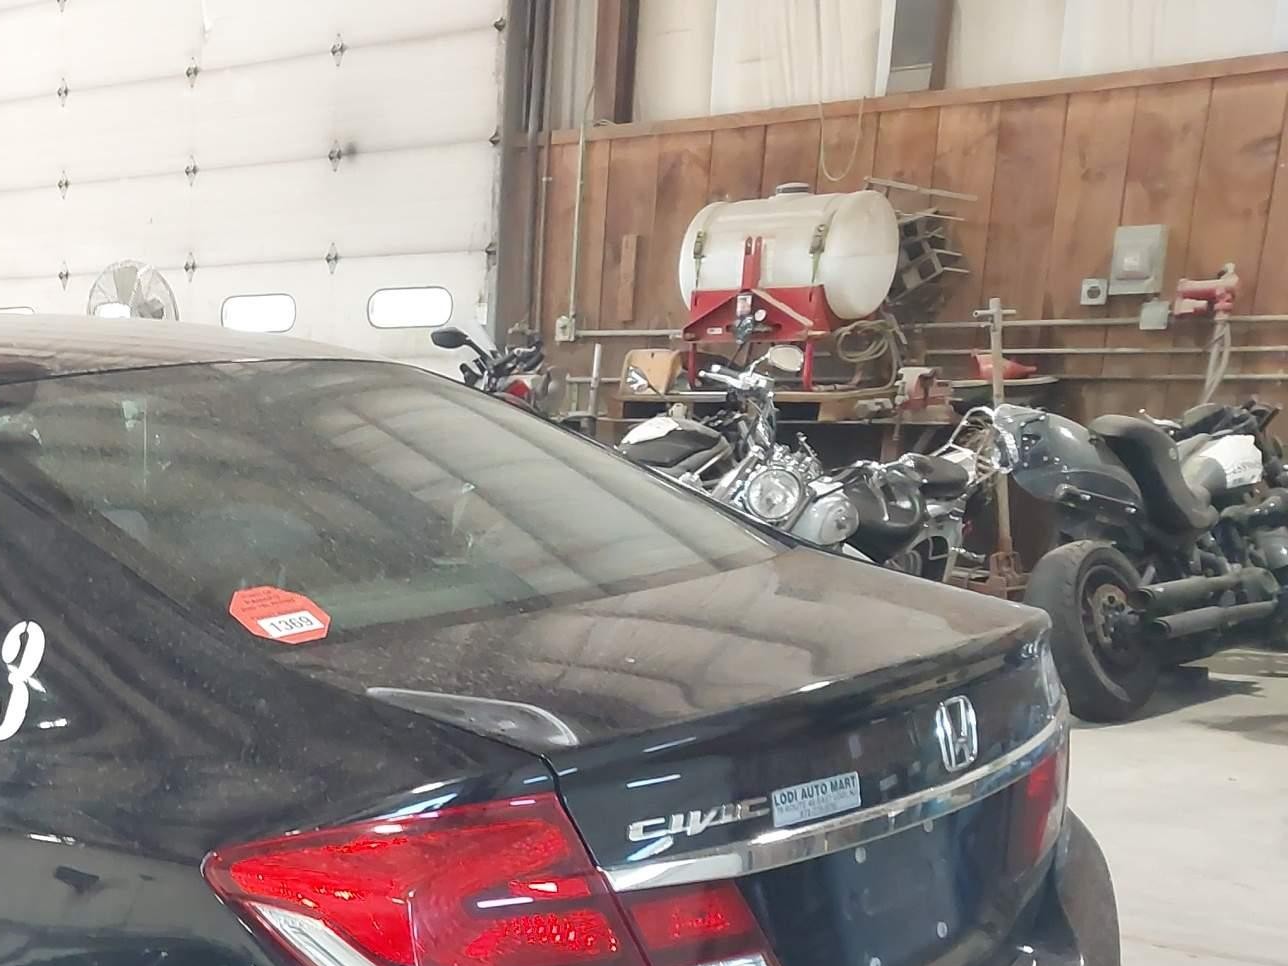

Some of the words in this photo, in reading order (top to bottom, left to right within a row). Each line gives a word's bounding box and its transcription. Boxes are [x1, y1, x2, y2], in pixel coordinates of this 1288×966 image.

[270, 615, 313, 632] 1369
[774, 789, 798, 807] LODI
[801, 783, 828, 800] AUTO
[830, 776, 856, 793] MART
[628, 797, 770, 842] CIVIC
